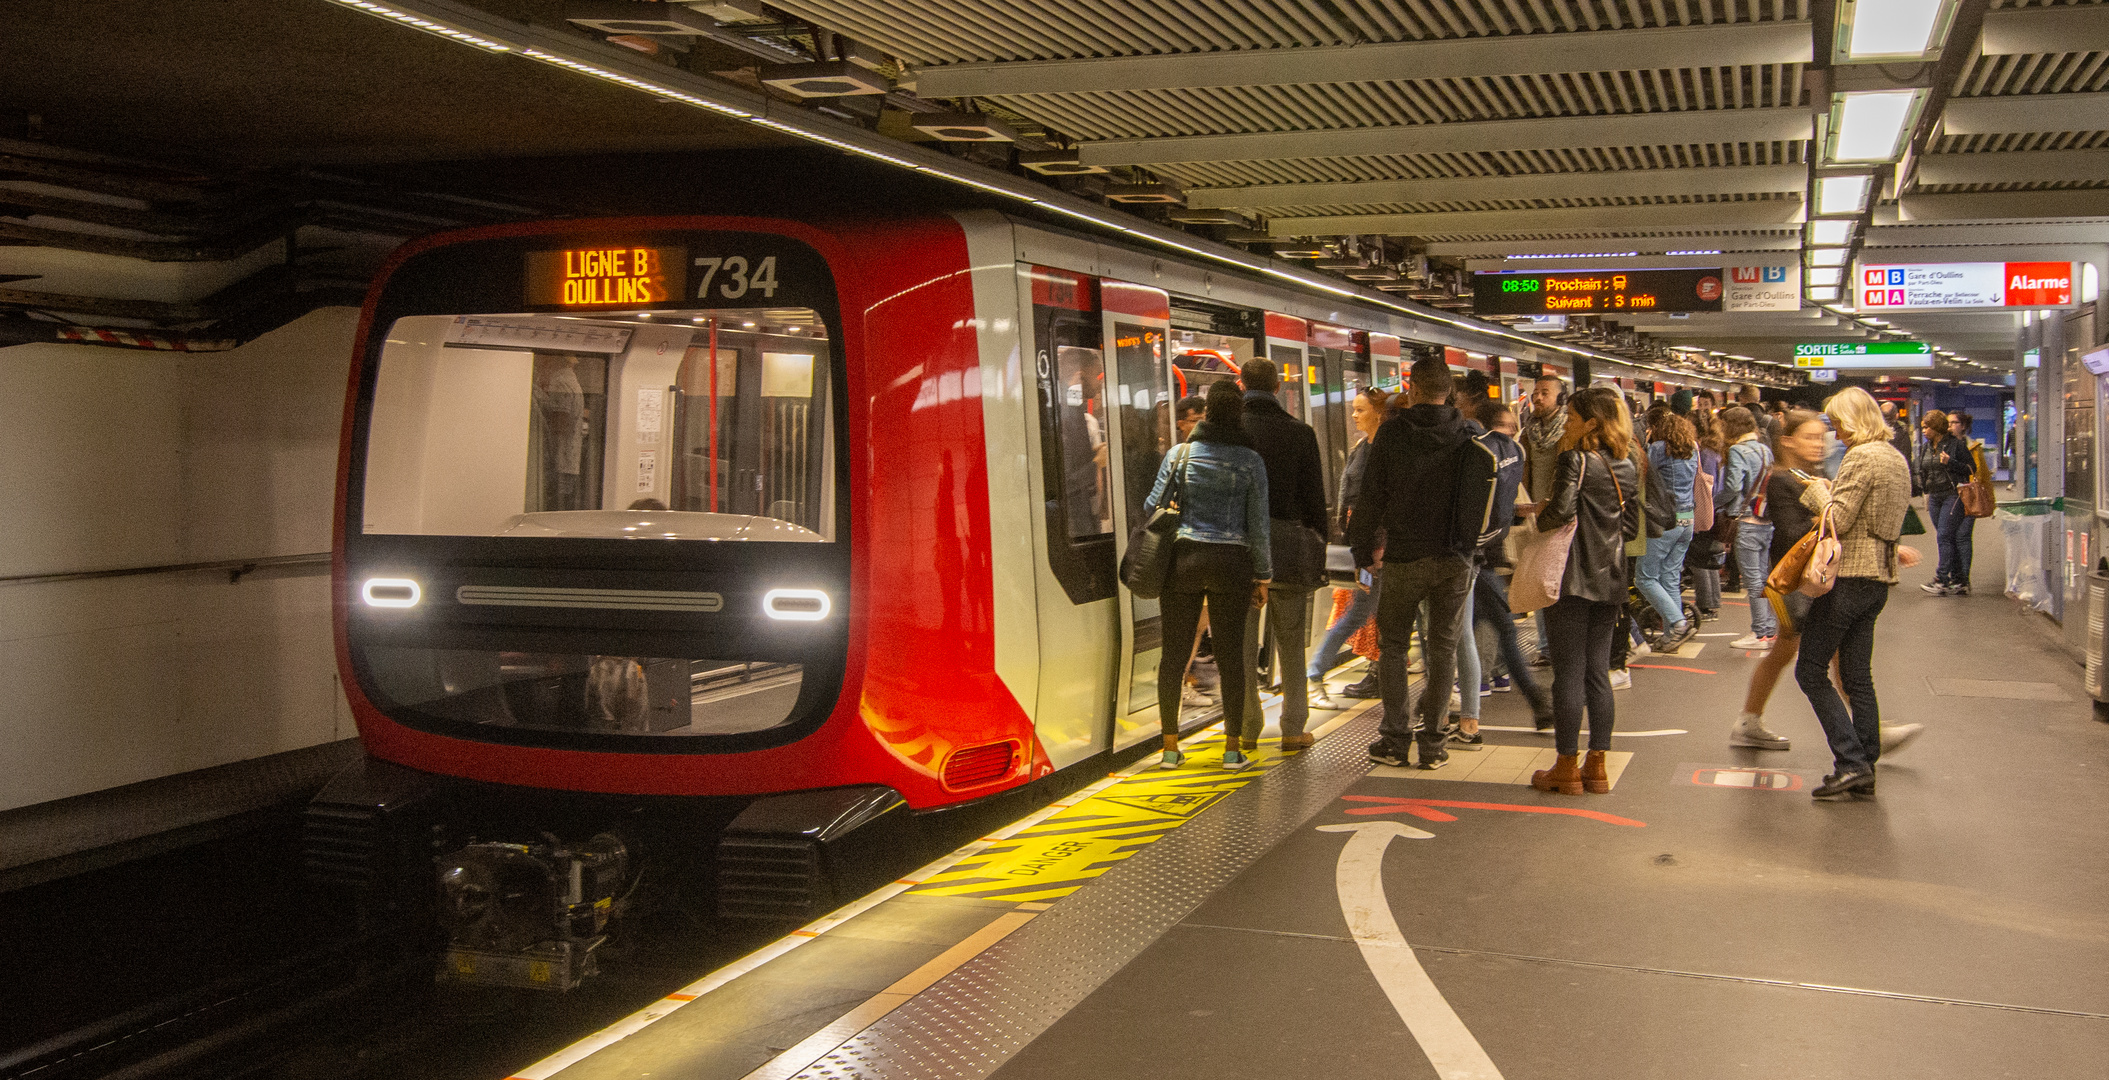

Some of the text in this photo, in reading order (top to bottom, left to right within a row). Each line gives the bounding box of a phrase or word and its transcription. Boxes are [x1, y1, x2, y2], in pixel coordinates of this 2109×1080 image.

[566, 248, 648, 278] LIGNE B
[694, 255, 779, 300] 734
[1738, 267, 1781, 279] M B
[1868, 271, 1902, 284] M B
[1928, 271, 1964, 279] d'Oullins
[1502, 279, 1539, 292] 08:50
[1545, 277, 1601, 292] Prochain
[2009, 275, 2069, 290] Alarme
[564, 277, 651, 305] OULLINS
[1731, 291, 1795, 300] Gare d'Oullins
[1868, 291, 1902, 304] M A
[1908, 291, 1942, 299] Perrache
[1545, 295, 1593, 309] Suivant
[1614, 294, 1625, 308] 3
[1631, 293, 1656, 308] min
[1796, 344, 1838, 355] SORTIE
[1007, 841, 1094, 876] DANGER
